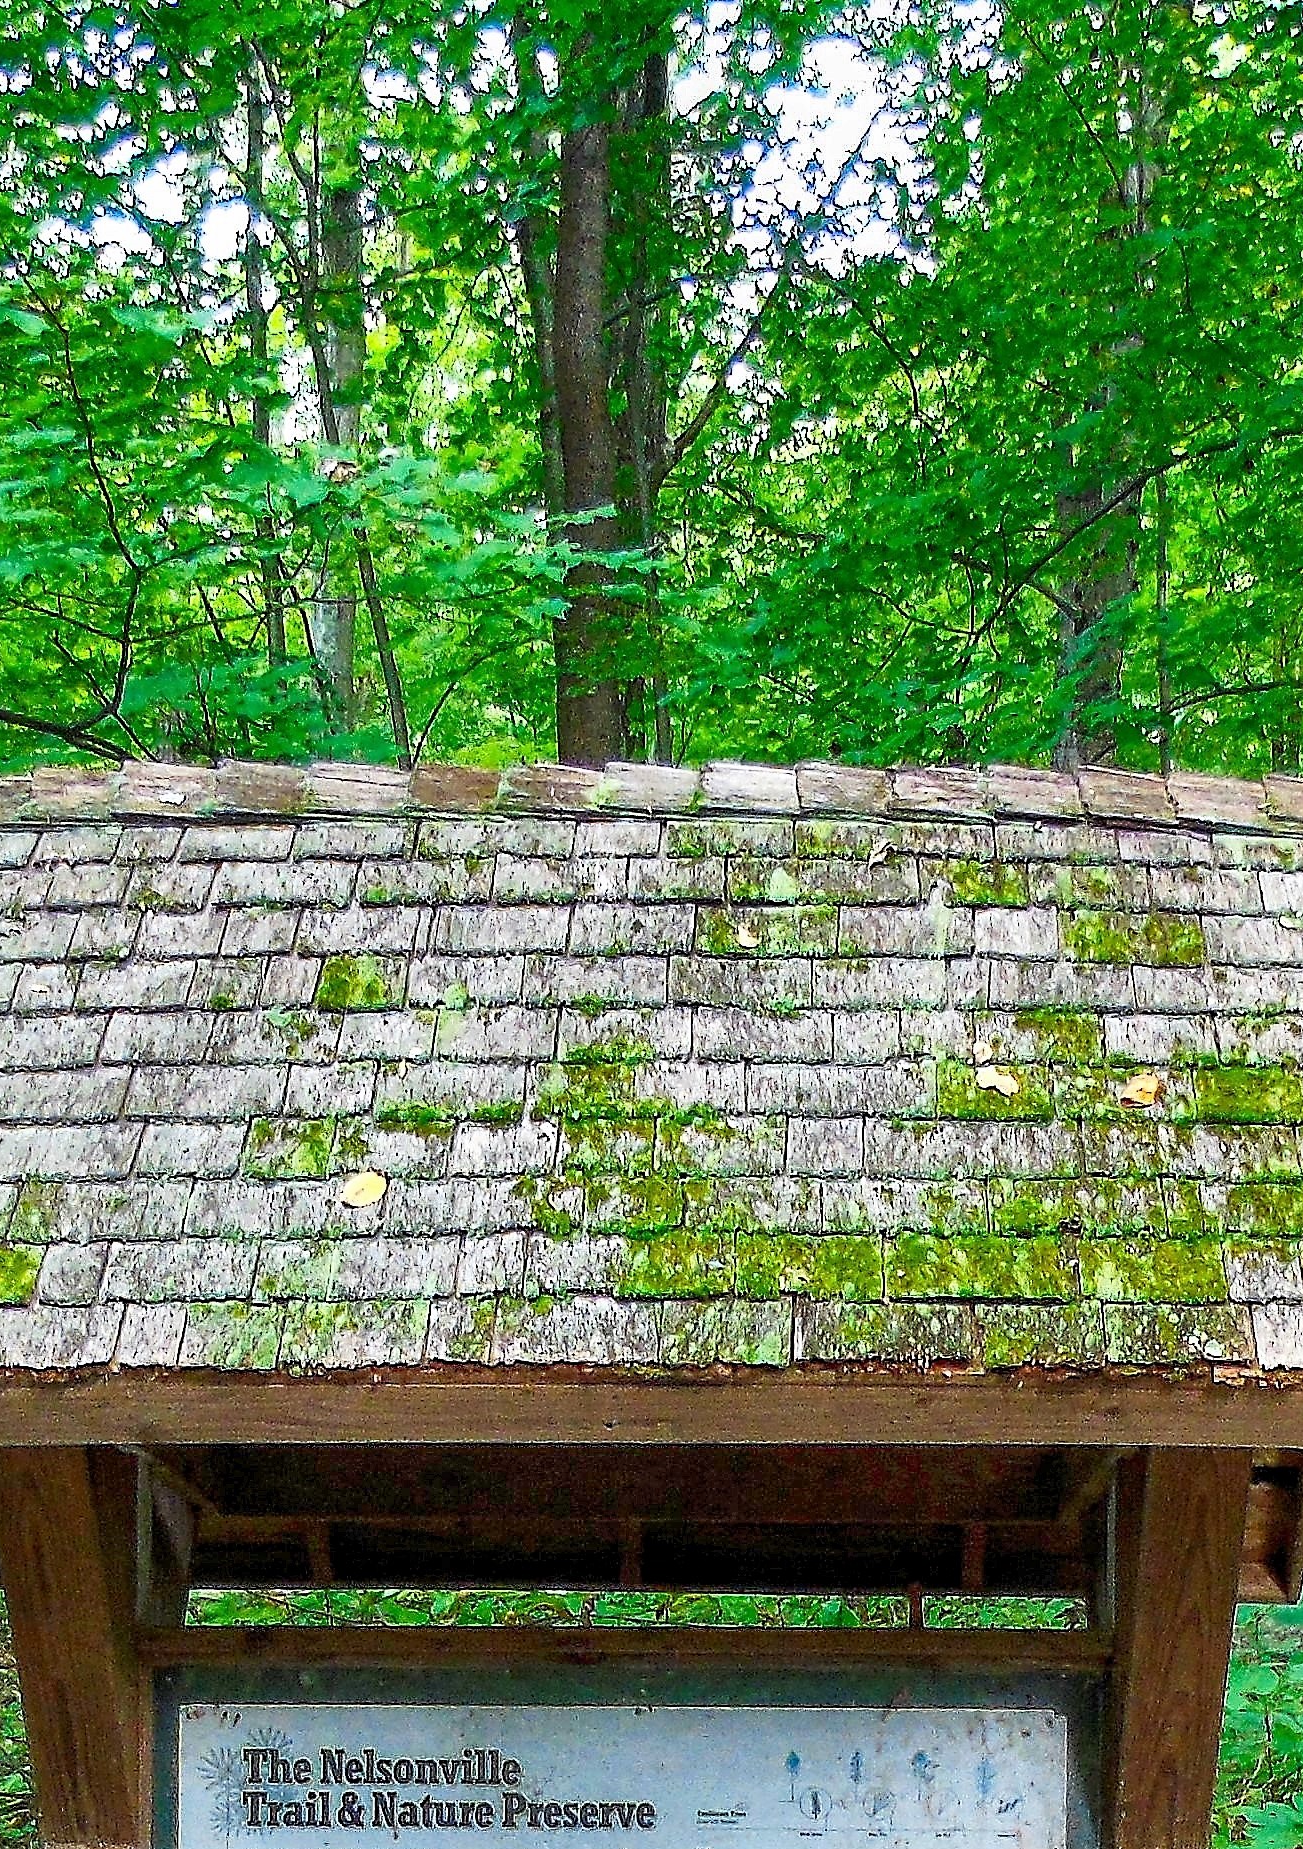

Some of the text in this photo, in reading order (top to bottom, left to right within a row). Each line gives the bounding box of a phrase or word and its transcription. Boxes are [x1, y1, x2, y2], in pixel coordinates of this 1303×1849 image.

[242, 1748, 522, 1786] The Nelsonville
[242, 1791, 656, 1829] Trail & Nature Preserve
